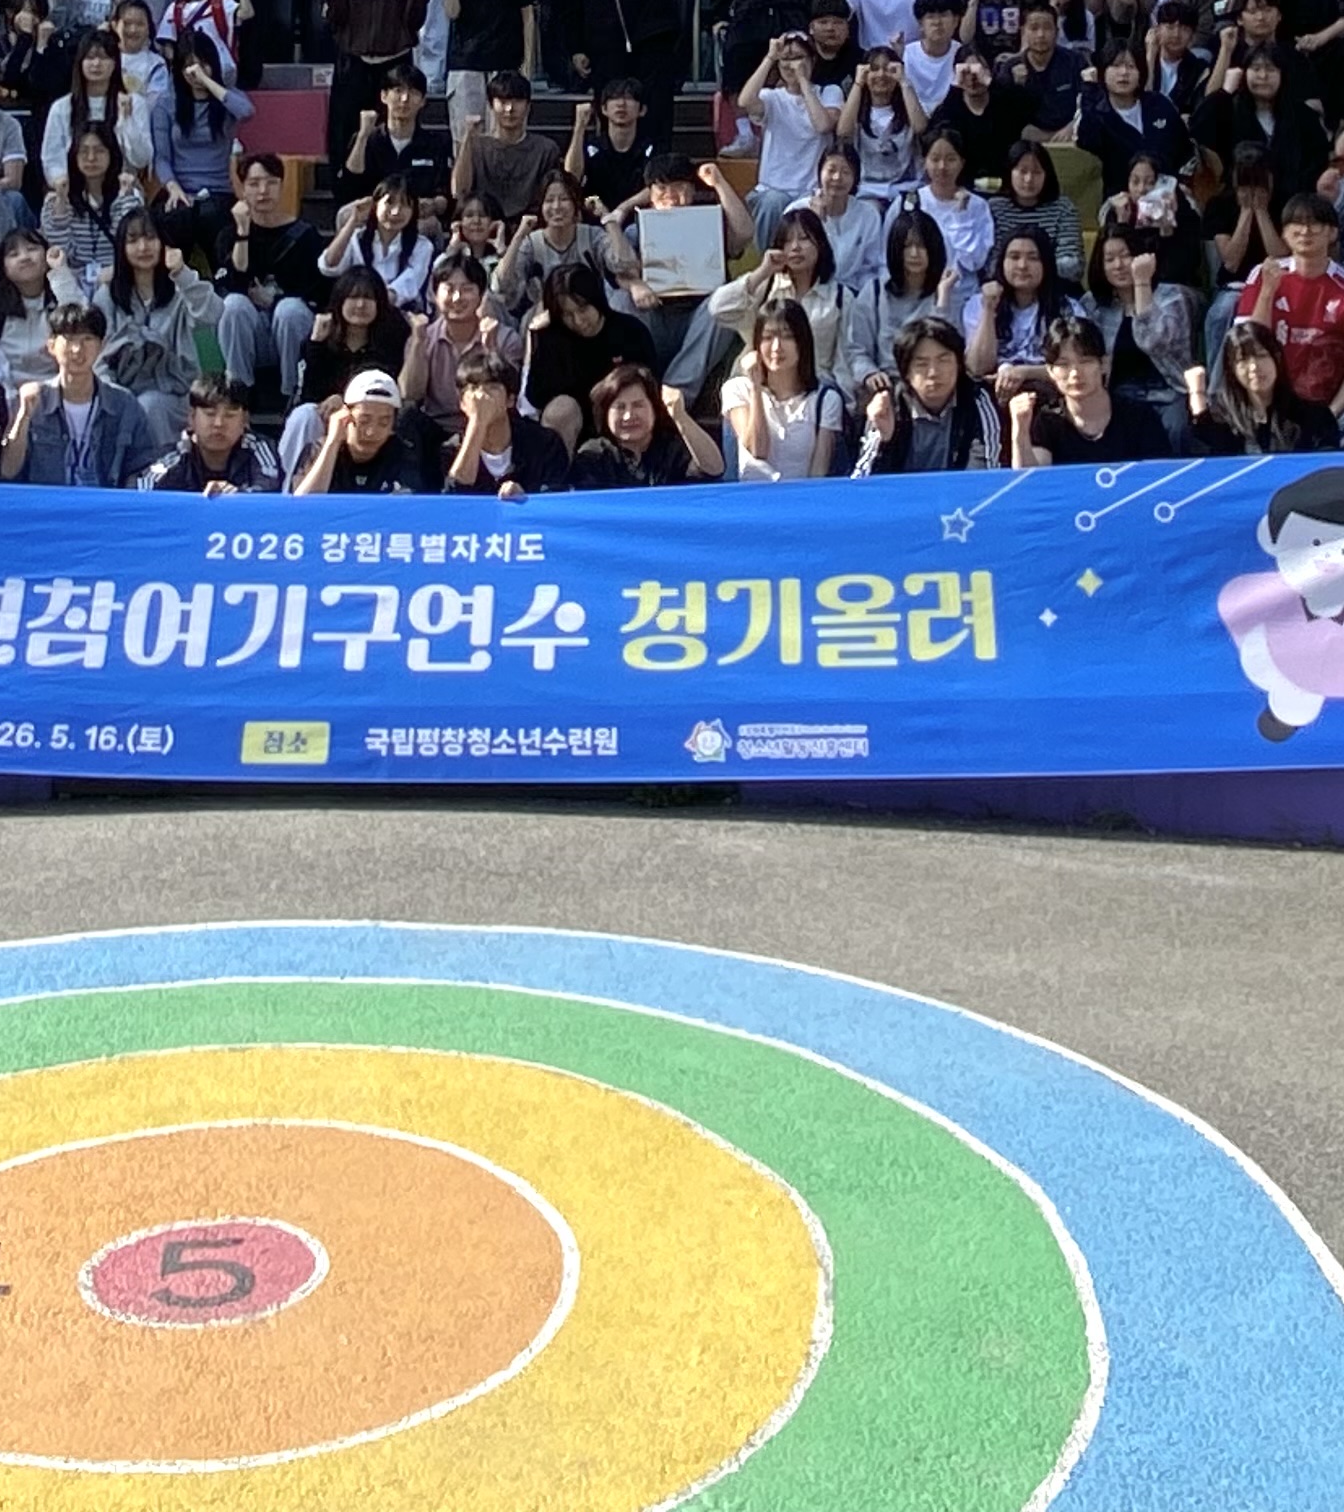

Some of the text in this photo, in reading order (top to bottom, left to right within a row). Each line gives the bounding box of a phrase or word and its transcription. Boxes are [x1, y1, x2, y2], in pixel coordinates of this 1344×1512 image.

[205, 532, 545, 563] 2026 강원특별자치도
[619, 570, 997, 670] 청기올려
[50, 724, 75, 750] 5.
[85, 725, 174, 755] 16.(토)
[364, 727, 619, 757] 국립평창청소년수련원
[149, 1237, 257, 1309] 5
